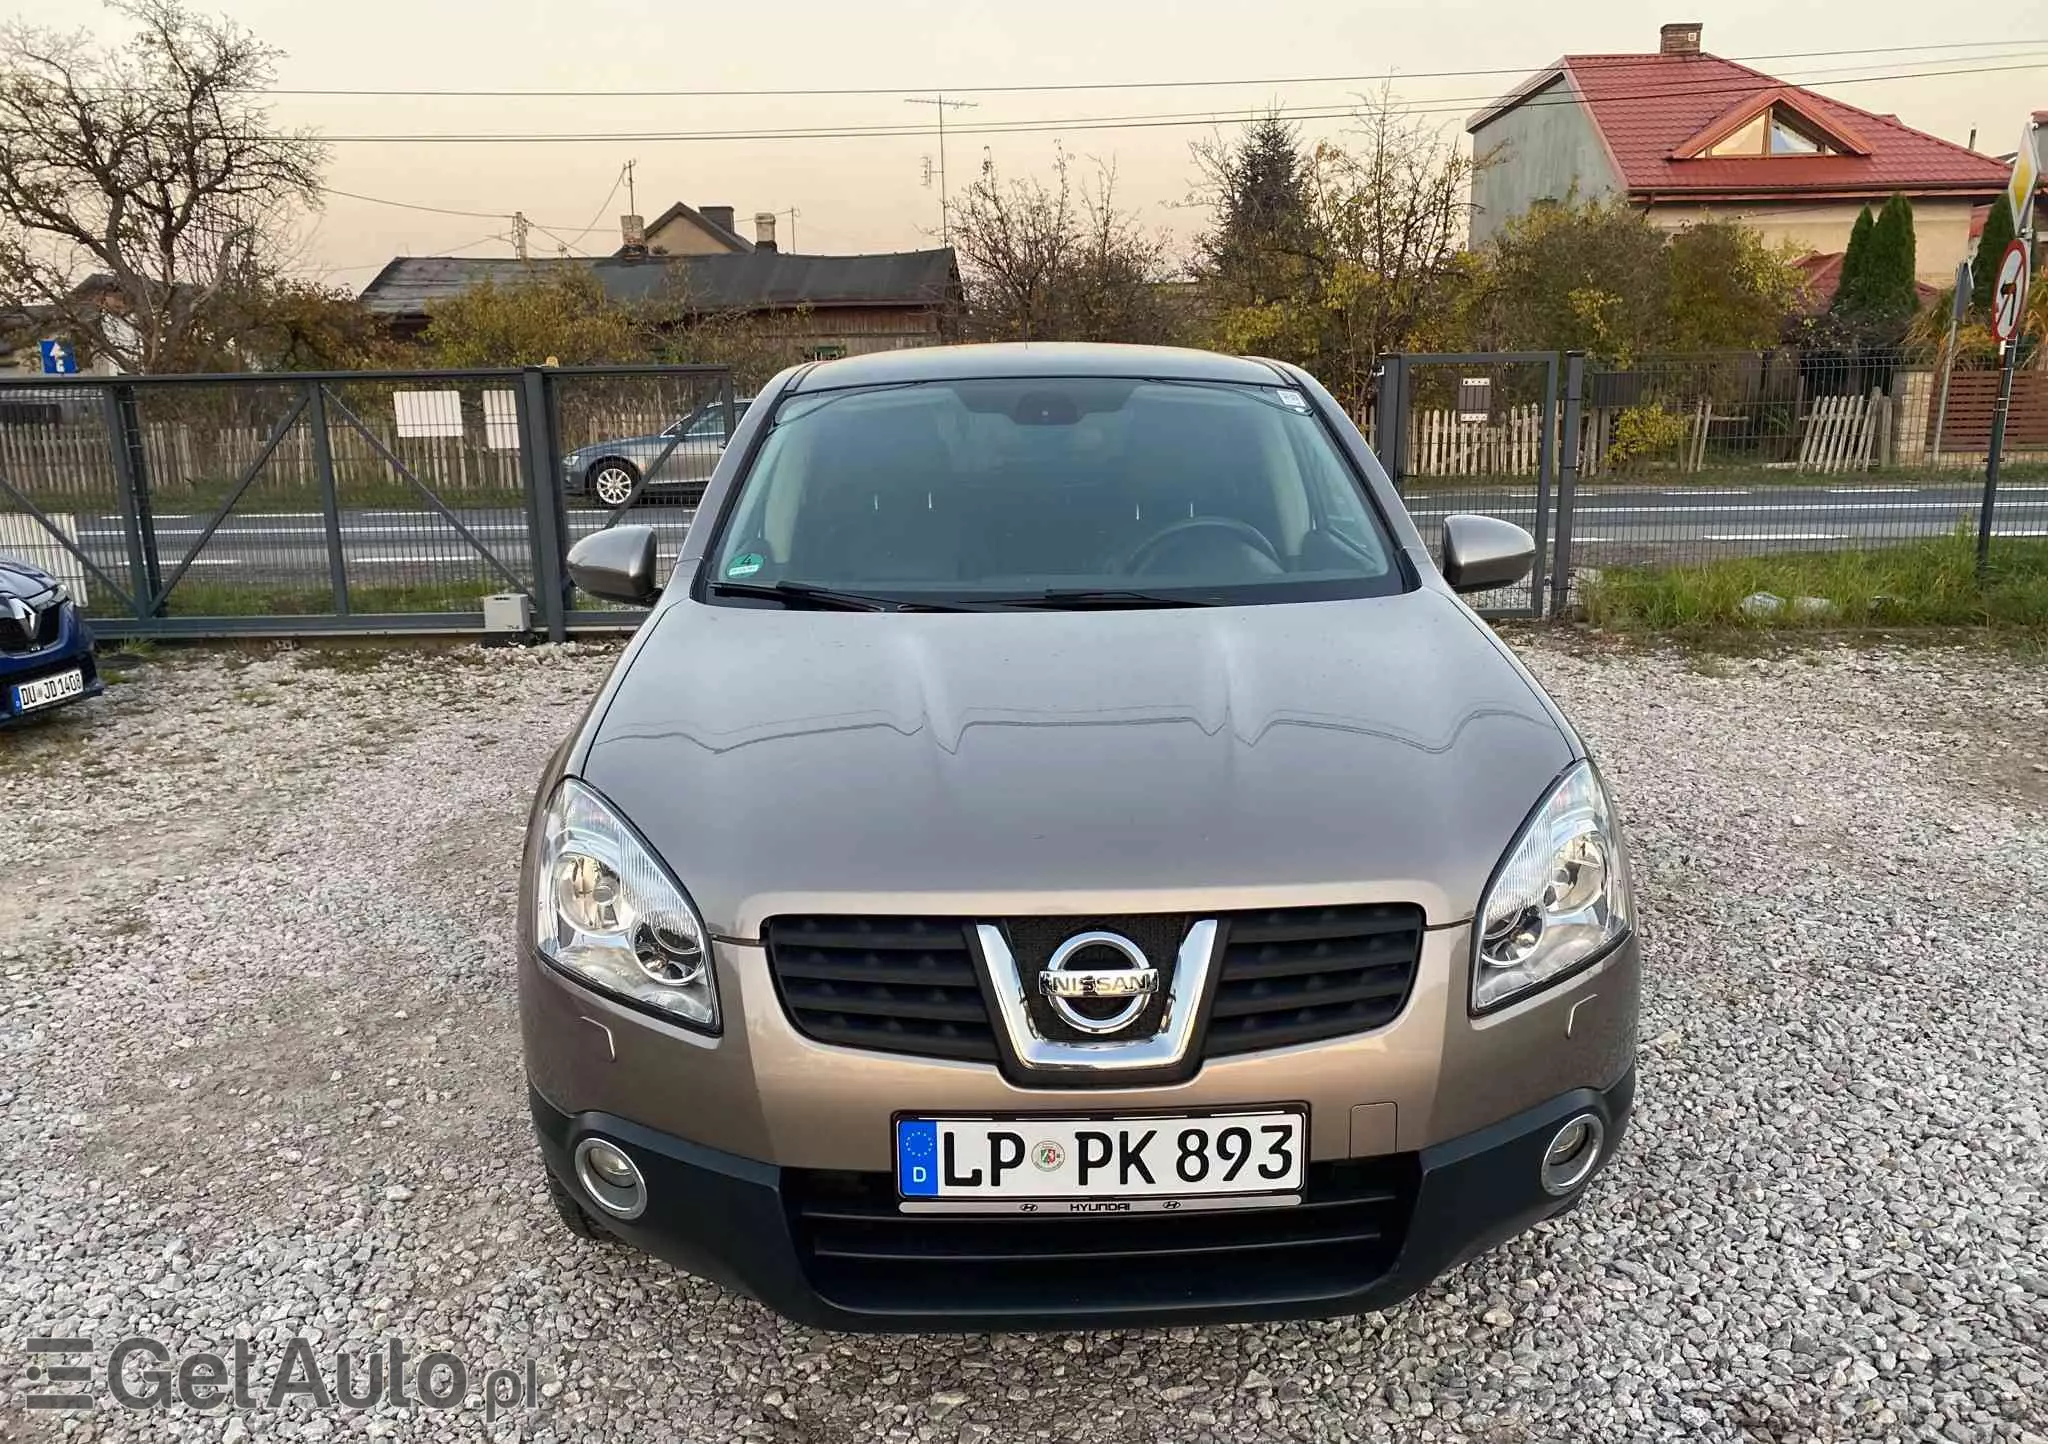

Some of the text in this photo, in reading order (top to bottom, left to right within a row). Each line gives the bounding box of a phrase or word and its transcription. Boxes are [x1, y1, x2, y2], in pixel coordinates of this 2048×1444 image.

[21, 673, 81, 705] DU JD 1408
[1051, 973, 1148, 993] NISSAN
[943, 1124, 1293, 1187] LP PK 893
[913, 1166, 926, 1183] D
[1069, 1202, 1130, 1212] HYUNDAI
